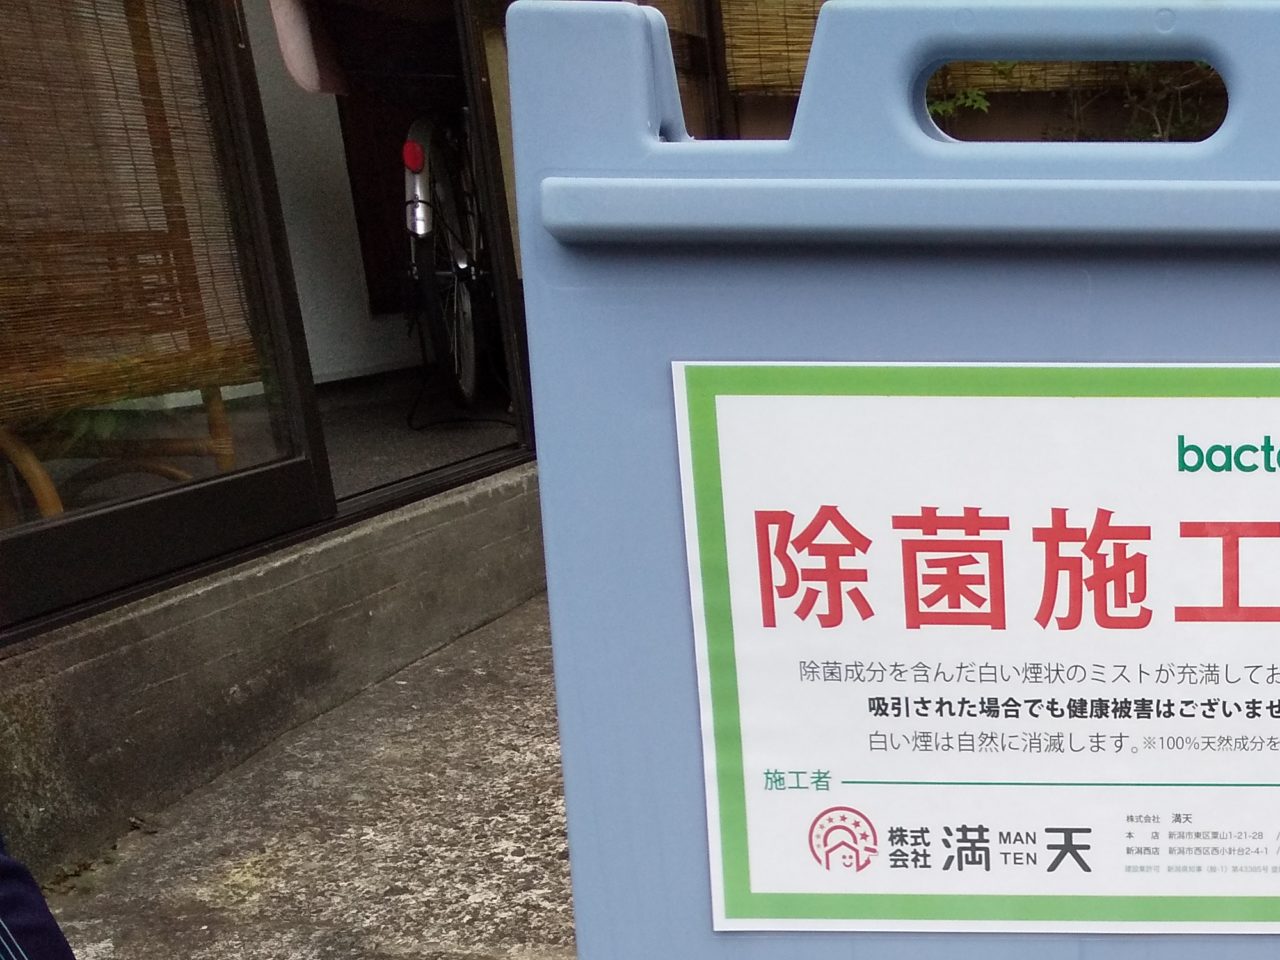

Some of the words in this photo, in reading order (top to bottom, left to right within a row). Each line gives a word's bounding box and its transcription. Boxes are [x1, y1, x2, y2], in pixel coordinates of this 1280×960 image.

[868, 730, 1138, 754] 白い煙は自然に消滅します。
[763, 768, 832, 792] 施工者
[1126, 814, 1161, 824] 株式会社
[1171, 813, 1193, 824] 満天
[887, 826, 931, 848] 株式
[941, 824, 991, 872] 満
[998, 831, 1037, 845] MAN
[888, 848, 932, 869] 会社
[999, 851, 1037, 866] TEN
[1044, 827, 1092, 873] 天
